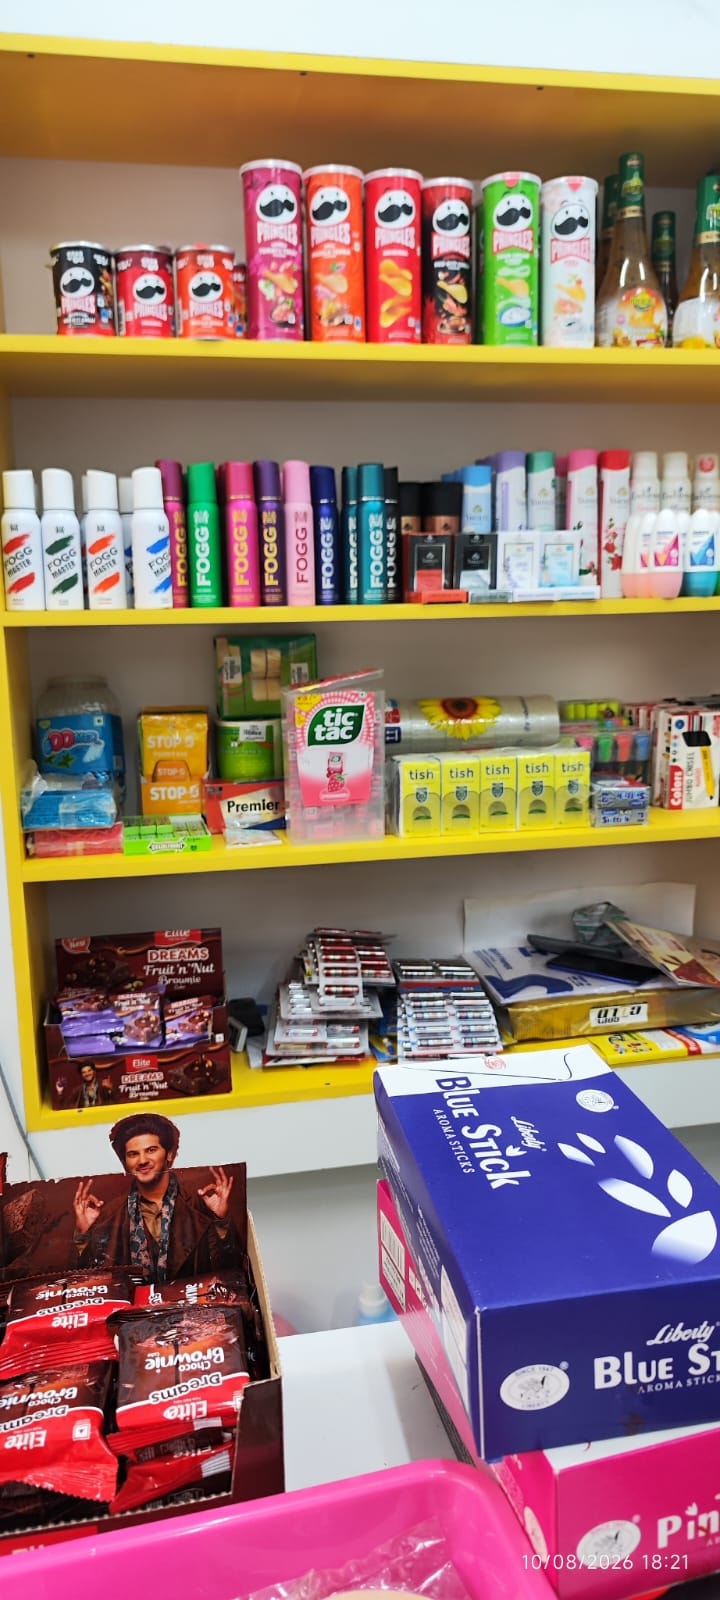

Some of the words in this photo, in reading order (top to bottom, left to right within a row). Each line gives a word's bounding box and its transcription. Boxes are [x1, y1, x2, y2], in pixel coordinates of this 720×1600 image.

[257, 220, 297, 246] PRINGLES
[311, 223, 350, 248] PRINGLES
[375, 227, 415, 249] PRINGLES
[493, 229, 533, 253] PRINGLES
[4, 547, 33, 568] FOGG
[47, 548, 77, 571] FOGG
[89, 546, 118, 570] FOGG
[148, 553, 169, 570] FOG
[194, 526, 211, 587] FOGG
[234, 526, 249, 586] FOGG
[264, 526, 279, 586] FOGG
[296, 527, 308, 584] FOGG
[321, 533, 334, 590] FOGG
[370, 530, 384, 588] FOGG
[8, 559, 31, 577] MASTER
[51, 561, 76, 578] MASTER
[93, 559, 117, 576] MASTER
[154, 561, 171, 576] MAST
[323, 708, 355, 727] tic
[315, 725, 353, 741] tac
[409, 769, 434, 780] tish
[449, 768, 474, 778] tish
[485, 764, 510, 775] tish
[525, 763, 549, 774] tish
[562, 762, 584, 773] tish
[670, 770, 683, 806] Colors
[227, 799, 280, 813] Premier
[147, 947, 209, 963] DREAMS
[132, 1058, 151, 1068] Elite
[433, 1108, 455, 1140] AROMA
[448, 1139, 476, 1174] STICKS
[510, 1115, 547, 1150] Liberty
[35, 1285, 108, 1300] Brownie
[36, 1297, 104, 1316] Dreams
[51, 1312, 89, 1329] Elite
[646, 1320, 715, 1346] Liberty
[145, 1347, 225, 1375] Brownie
[178, 1360, 211, 1372] Choco
[149, 1372, 222, 1404] Dreams
[638, 1380, 683, 1394] AROMA
[28, 1396, 62, 1406] Choco
[163, 1399, 208, 1421] Elite
[4, 1428, 47, 1450] Elite
[657, 1509, 720, 1549] Pin
